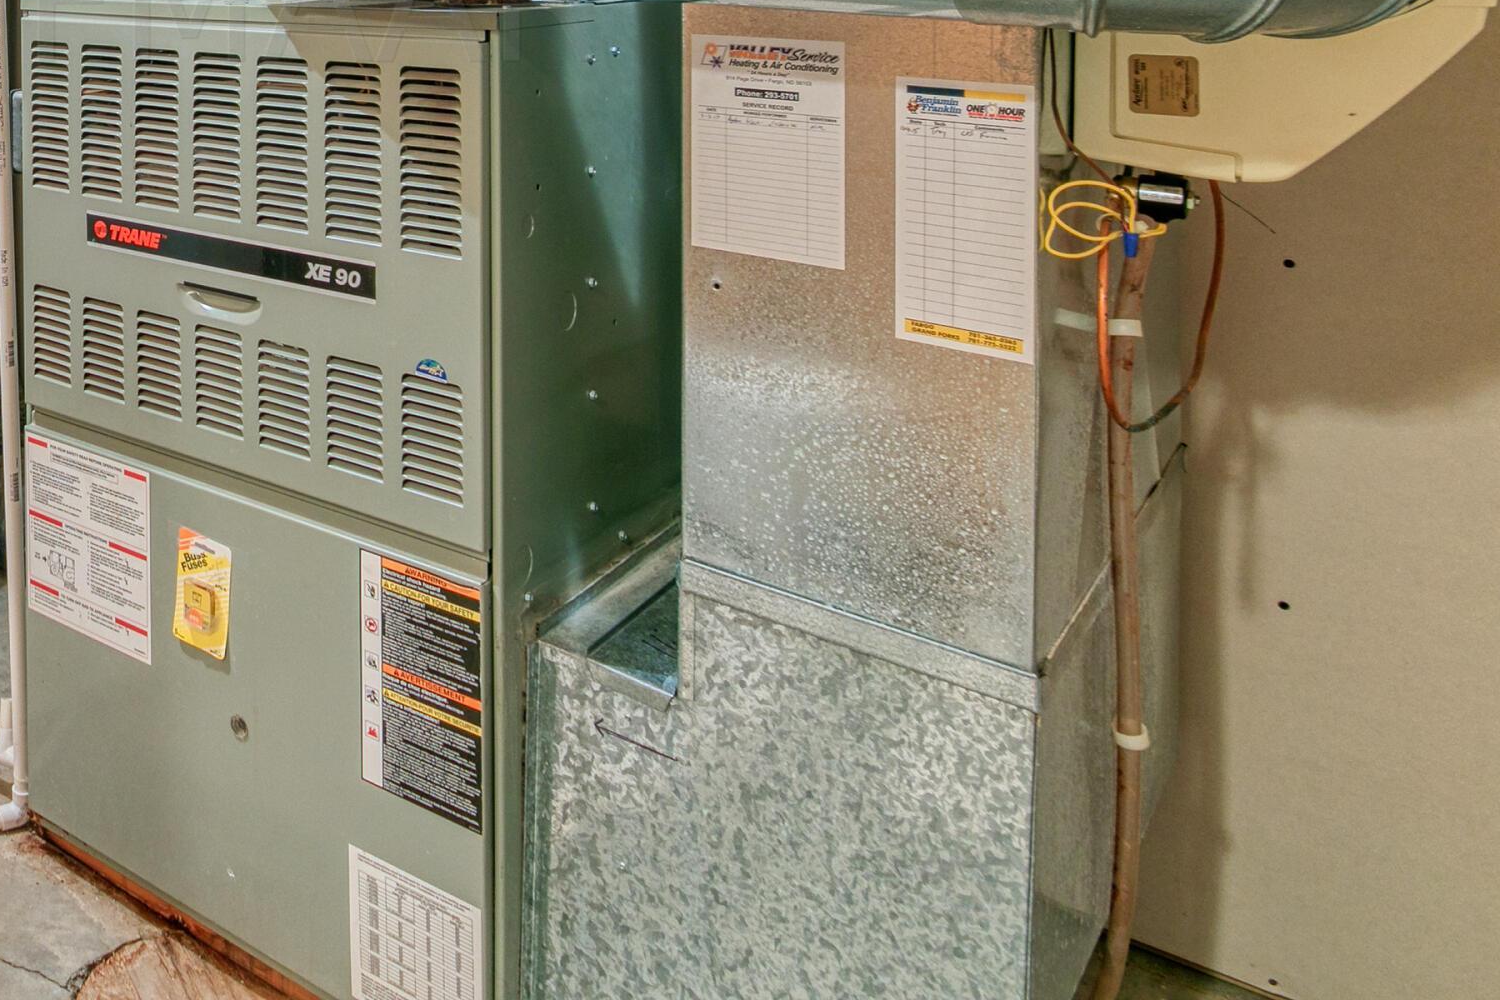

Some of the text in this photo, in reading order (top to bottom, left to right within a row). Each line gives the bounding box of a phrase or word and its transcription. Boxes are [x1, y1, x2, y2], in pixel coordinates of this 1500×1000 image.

[787, 49, 840, 64] Service
[729, 58, 840, 76] Heating & Air Conditioning
[736, 88, 799, 101] Phone: 293-5701
[915, 95, 959, 106] Benjamin
[742, 101, 794, 112] SERVICE RECORD
[922, 103, 962, 115] Franklin
[966, 104, 986, 113] ONE
[998, 107, 1026, 117] HOUR
[109, 224, 162, 250] TRANE
[304, 261, 362, 289] XE 90
[181, 559, 208, 573] Fuses
[449, 603, 474, 619] SAFETY
